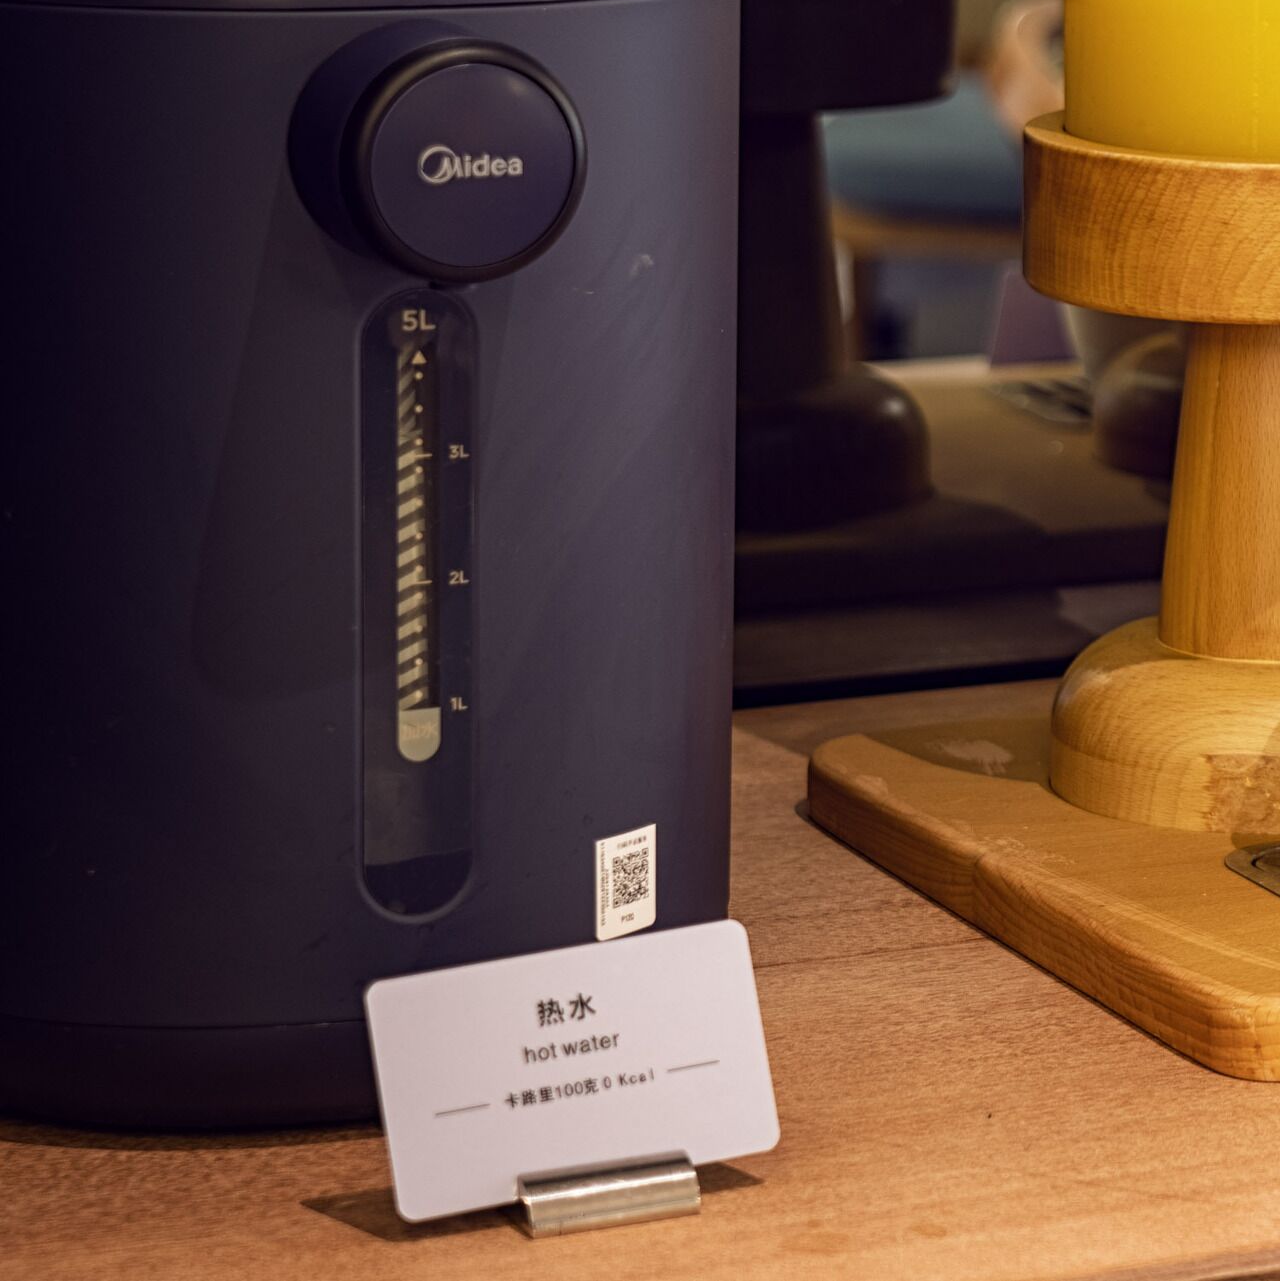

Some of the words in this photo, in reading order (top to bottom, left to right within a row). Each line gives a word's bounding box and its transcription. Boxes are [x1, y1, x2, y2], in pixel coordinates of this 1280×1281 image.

[418, 145, 523, 184] Midea
[402, 310, 436, 331] 5L
[448, 445, 469, 459] 3L
[448, 570, 469, 584] 2L
[450, 697, 468, 711] 1L
[537, 993, 595, 1027] 热水
[522, 1043, 557, 1064] hot
[561, 1034, 619, 1056] water
[505, 1078, 598, 1108] 卡路里100克
